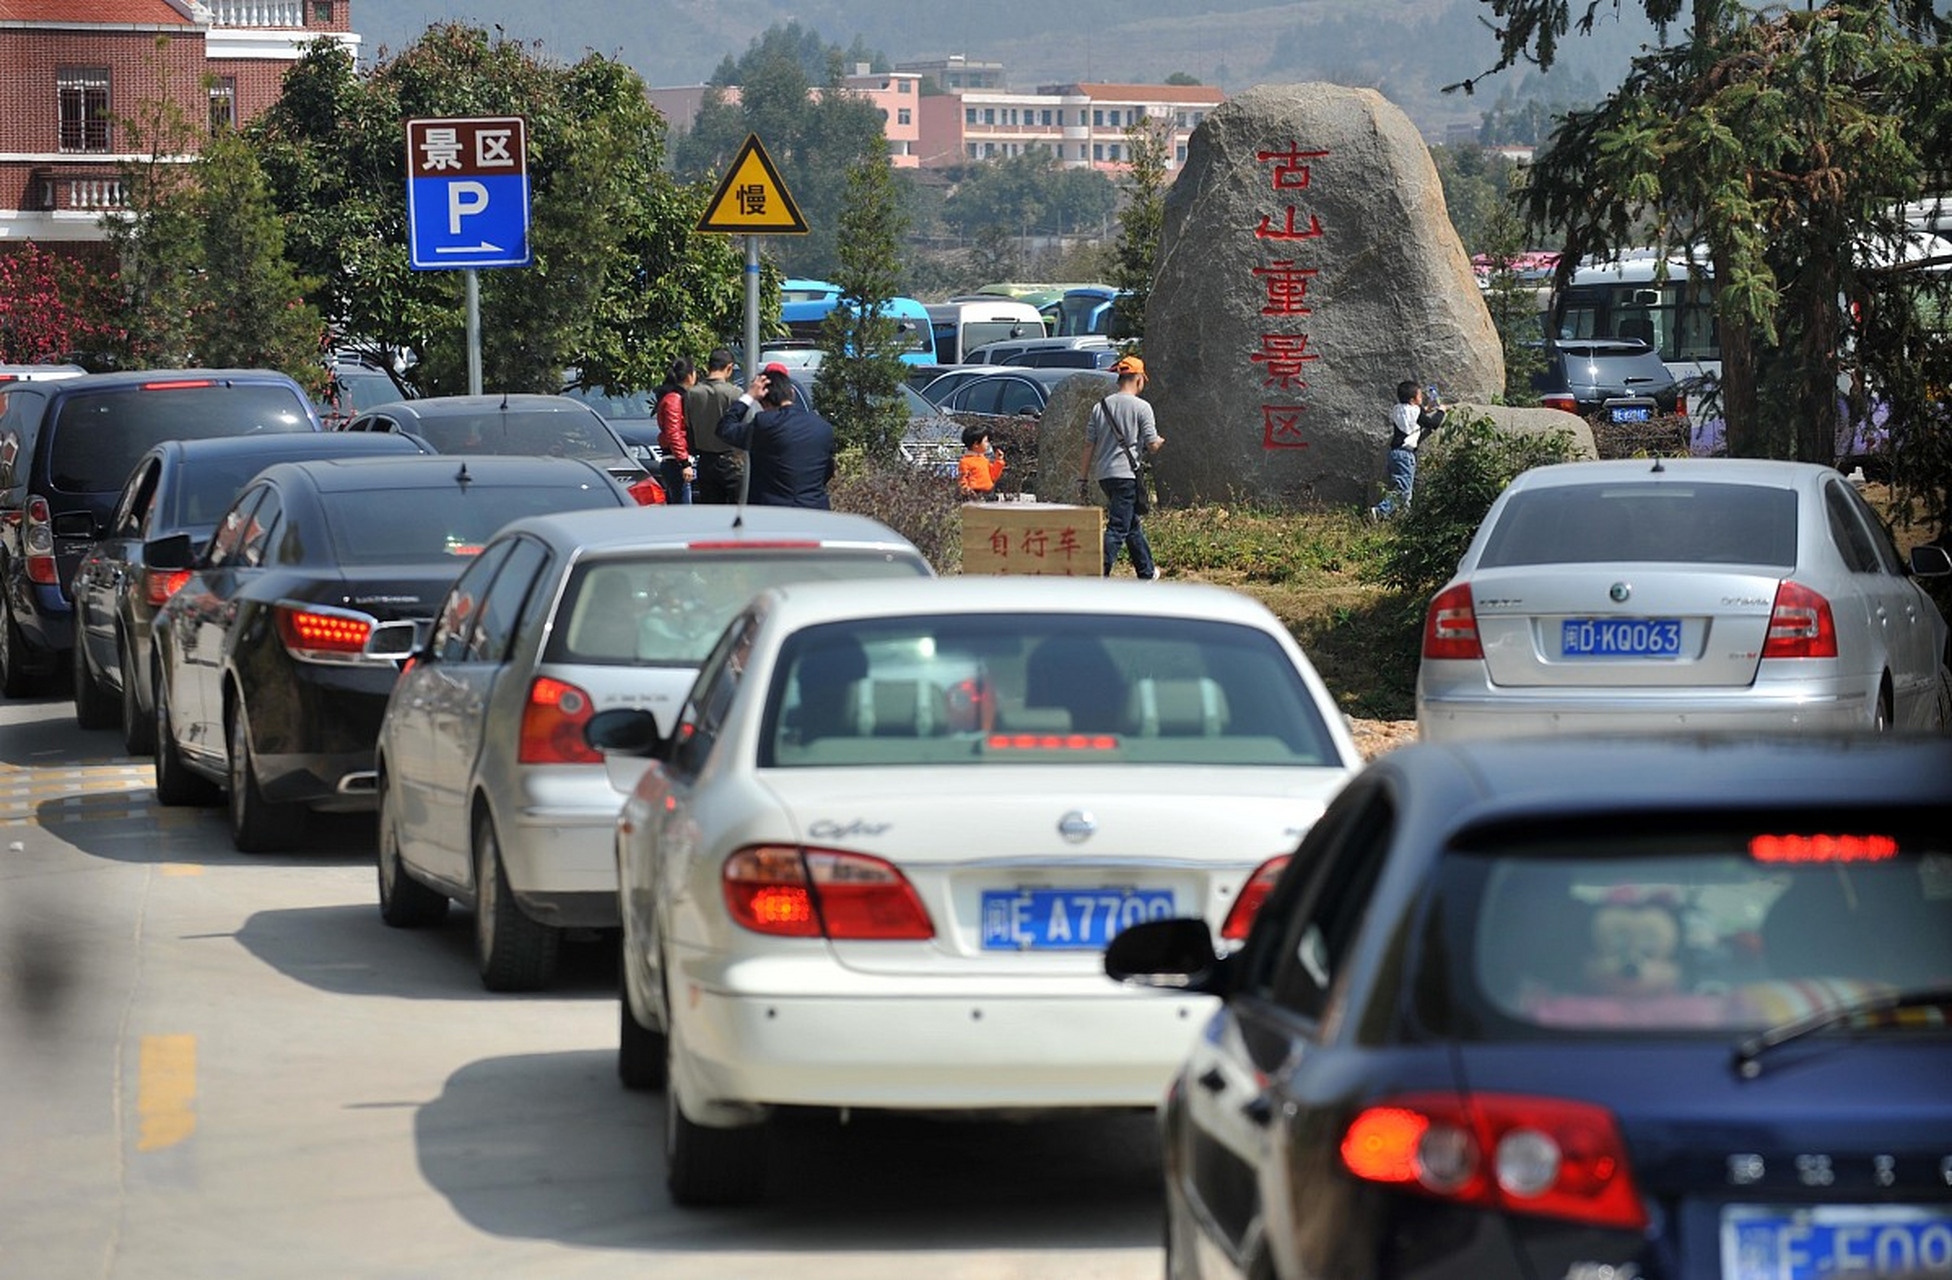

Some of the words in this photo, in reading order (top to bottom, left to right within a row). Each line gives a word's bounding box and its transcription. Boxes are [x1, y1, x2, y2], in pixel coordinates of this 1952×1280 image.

[419, 127, 515, 171] 景区
[448, 180, 490, 235] P
[736, 184, 767, 216] 慢
[1250, 139, 1330, 450] 古山重景区
[988, 525, 1082, 561] 自行车
